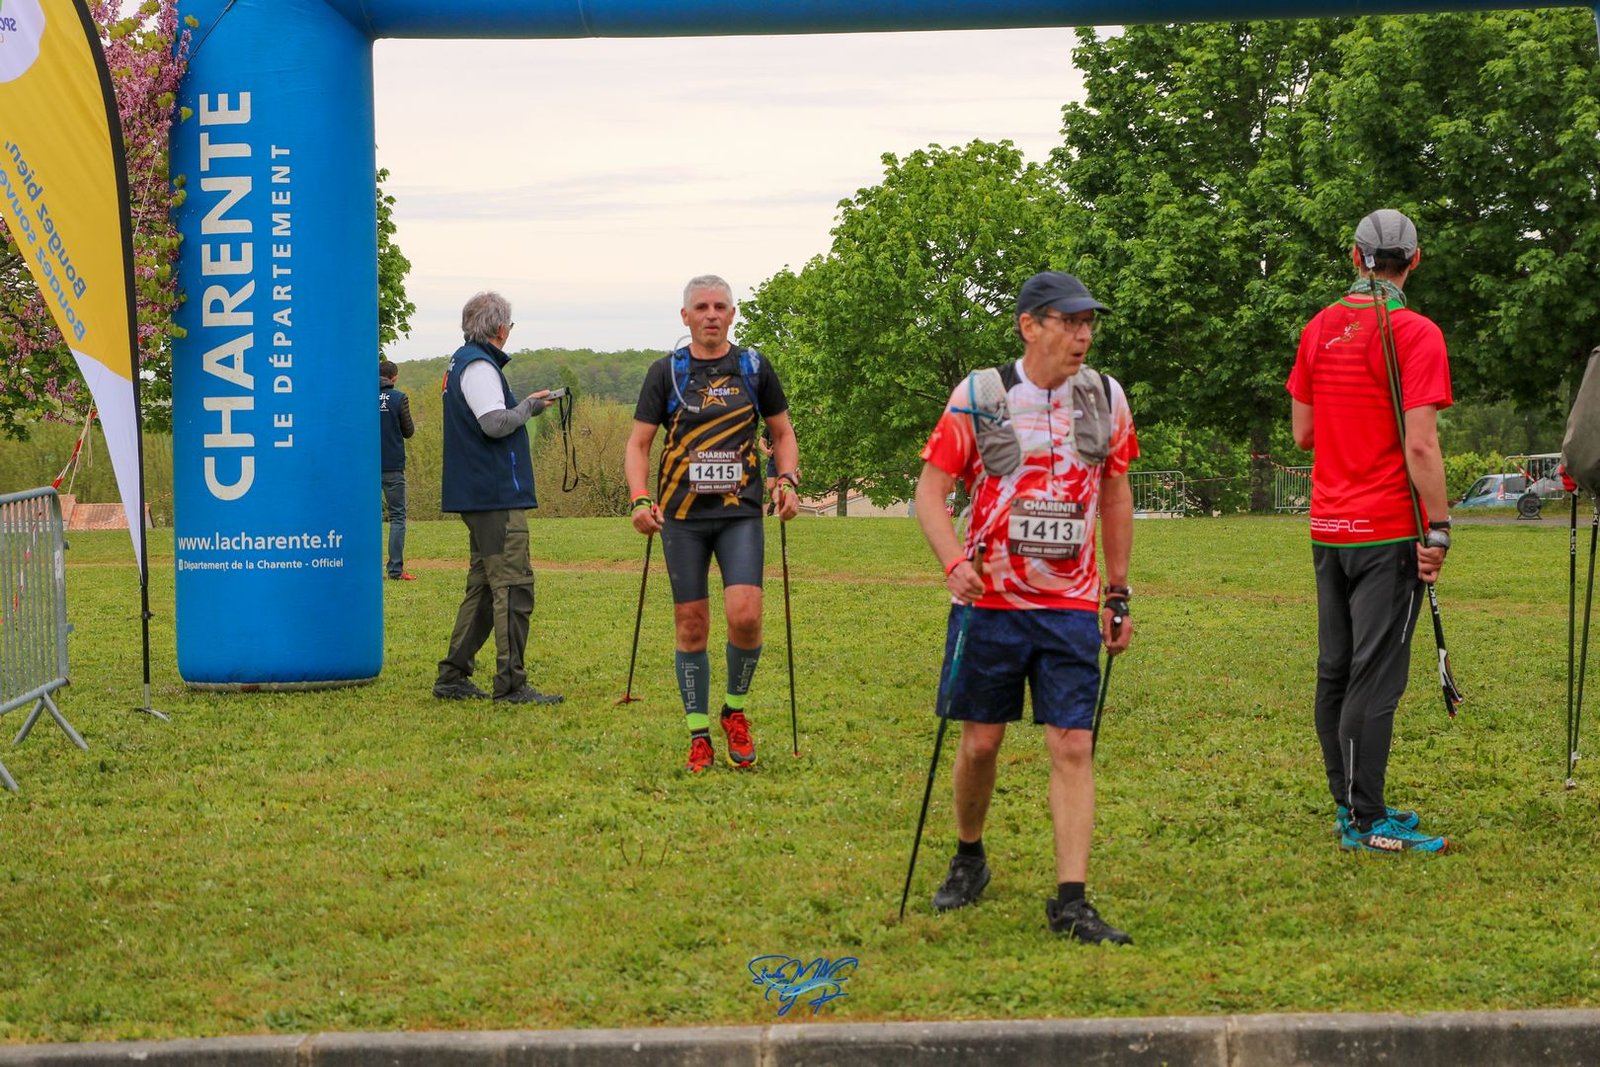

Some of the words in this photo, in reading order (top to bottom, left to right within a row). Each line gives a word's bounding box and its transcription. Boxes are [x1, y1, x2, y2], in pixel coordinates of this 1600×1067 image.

[268, 144, 293, 393] DÉPARTEMENT
[199, 91, 256, 501] CHARENTE
[274, 413, 293, 448] LE
[697, 451, 736, 460] CHARENTE
[695, 465, 735, 480] 1415
[1023, 501, 1077, 513] CHARENTE
[1020, 520, 1073, 541] 1413
[178, 530, 343, 551] www.lacharente.fr
[231, 560, 243, 570] de
[245, 560, 255, 569] la
[257, 559, 303, 569] Charente
[311, 558, 343, 568] Officiel
[1369, 835, 1402, 850] HOKA
